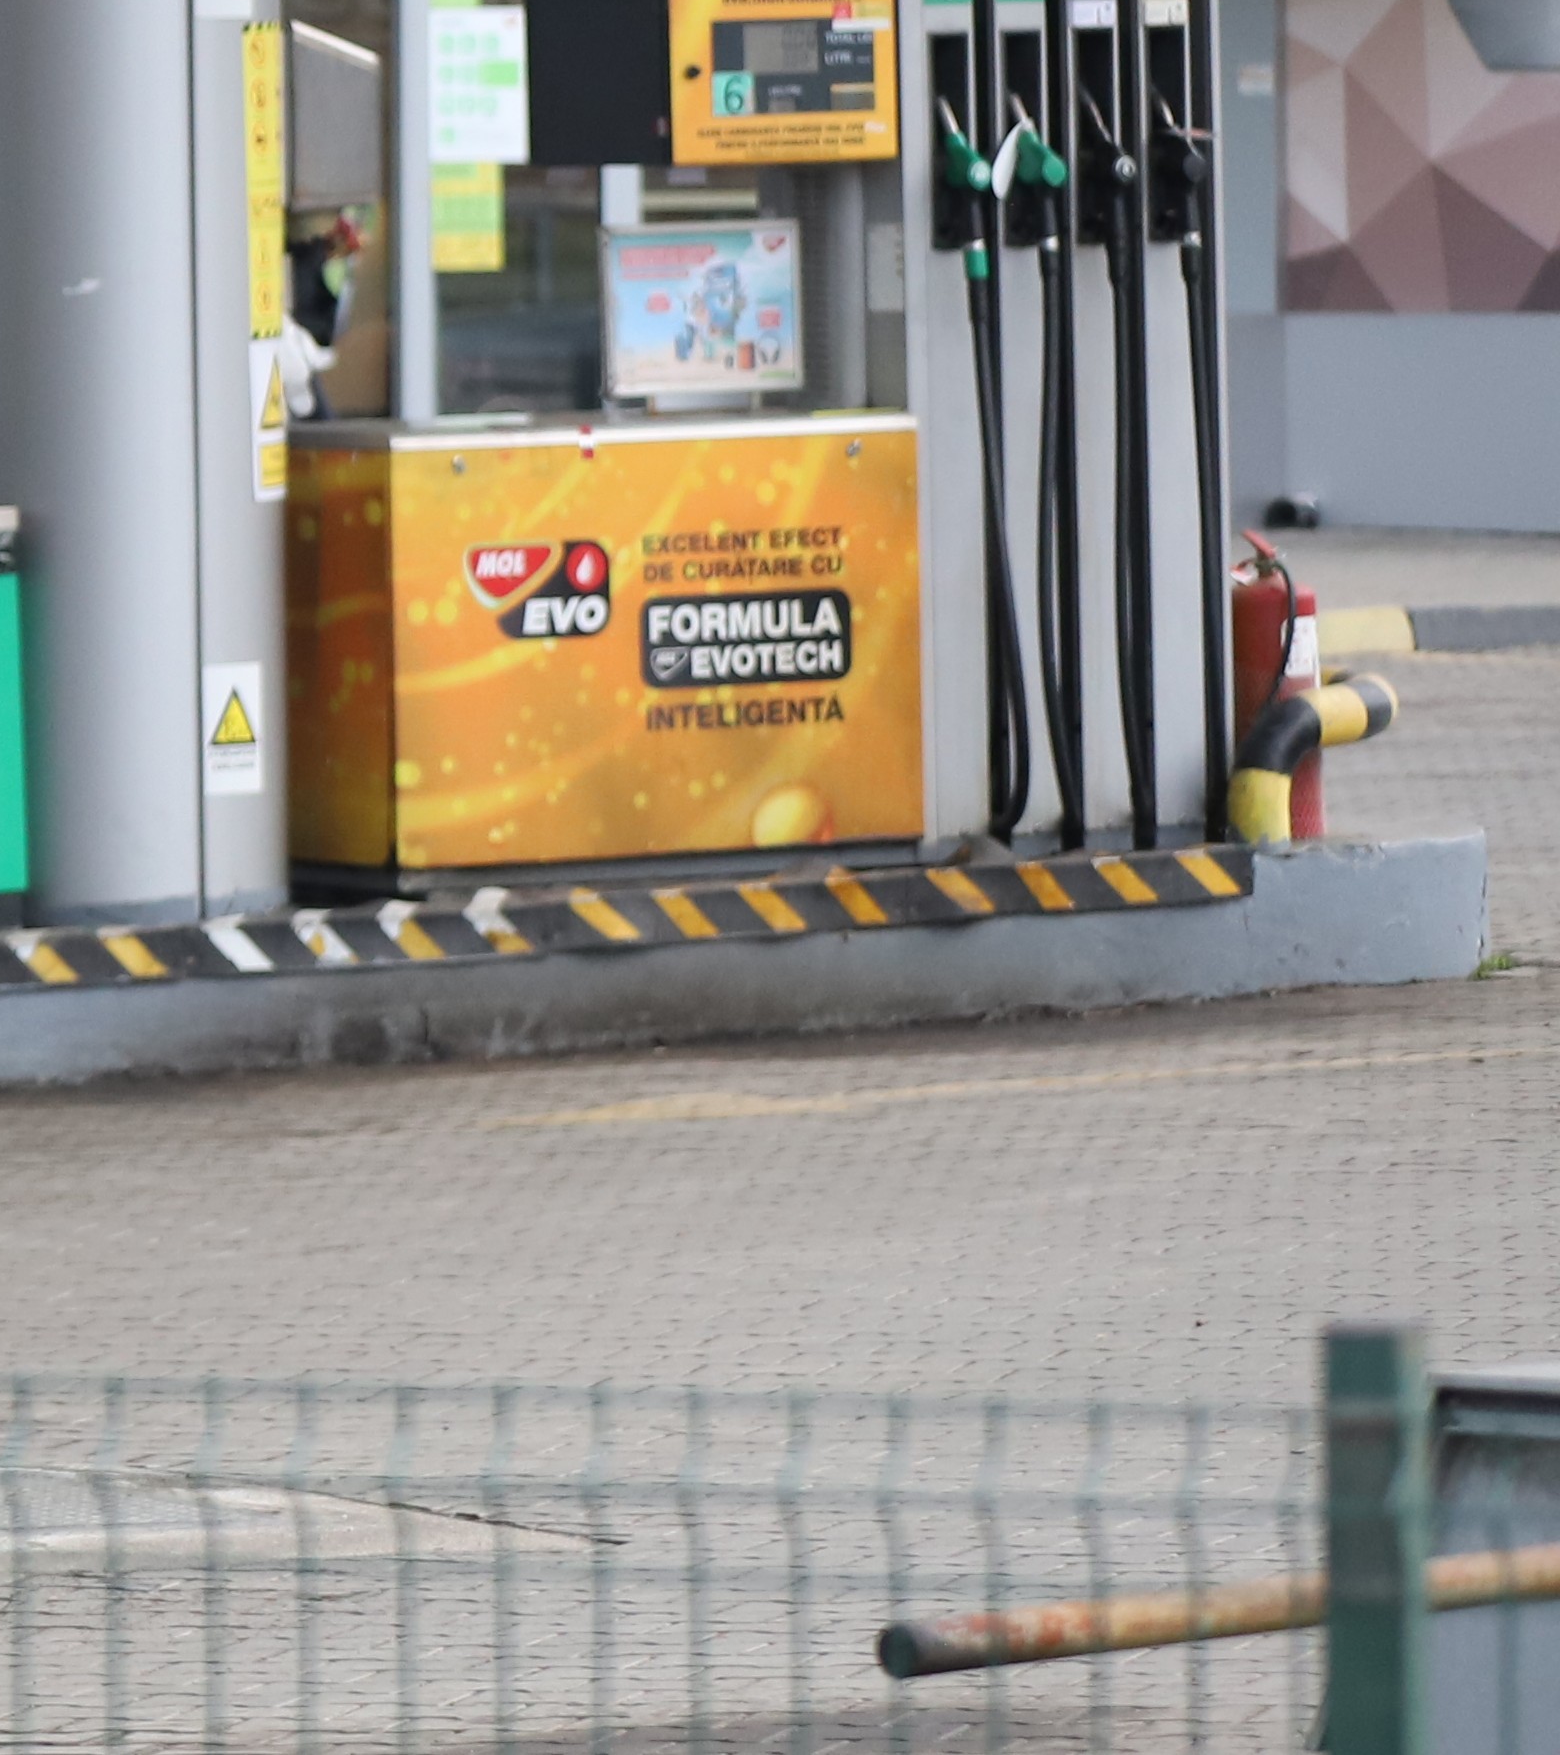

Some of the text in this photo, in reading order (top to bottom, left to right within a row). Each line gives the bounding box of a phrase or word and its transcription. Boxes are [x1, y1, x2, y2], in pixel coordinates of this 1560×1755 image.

[723, 76, 744, 114] 6
[642, 527, 842, 555] EXCELENT EFECT
[475, 551, 526, 578] MOL
[644, 562, 672, 581] DE
[811, 555, 842, 573] CU
[522, 596, 607, 634] EVO
[648, 597, 841, 644] FORMULA
[691, 639, 844, 679] EVOTECH
